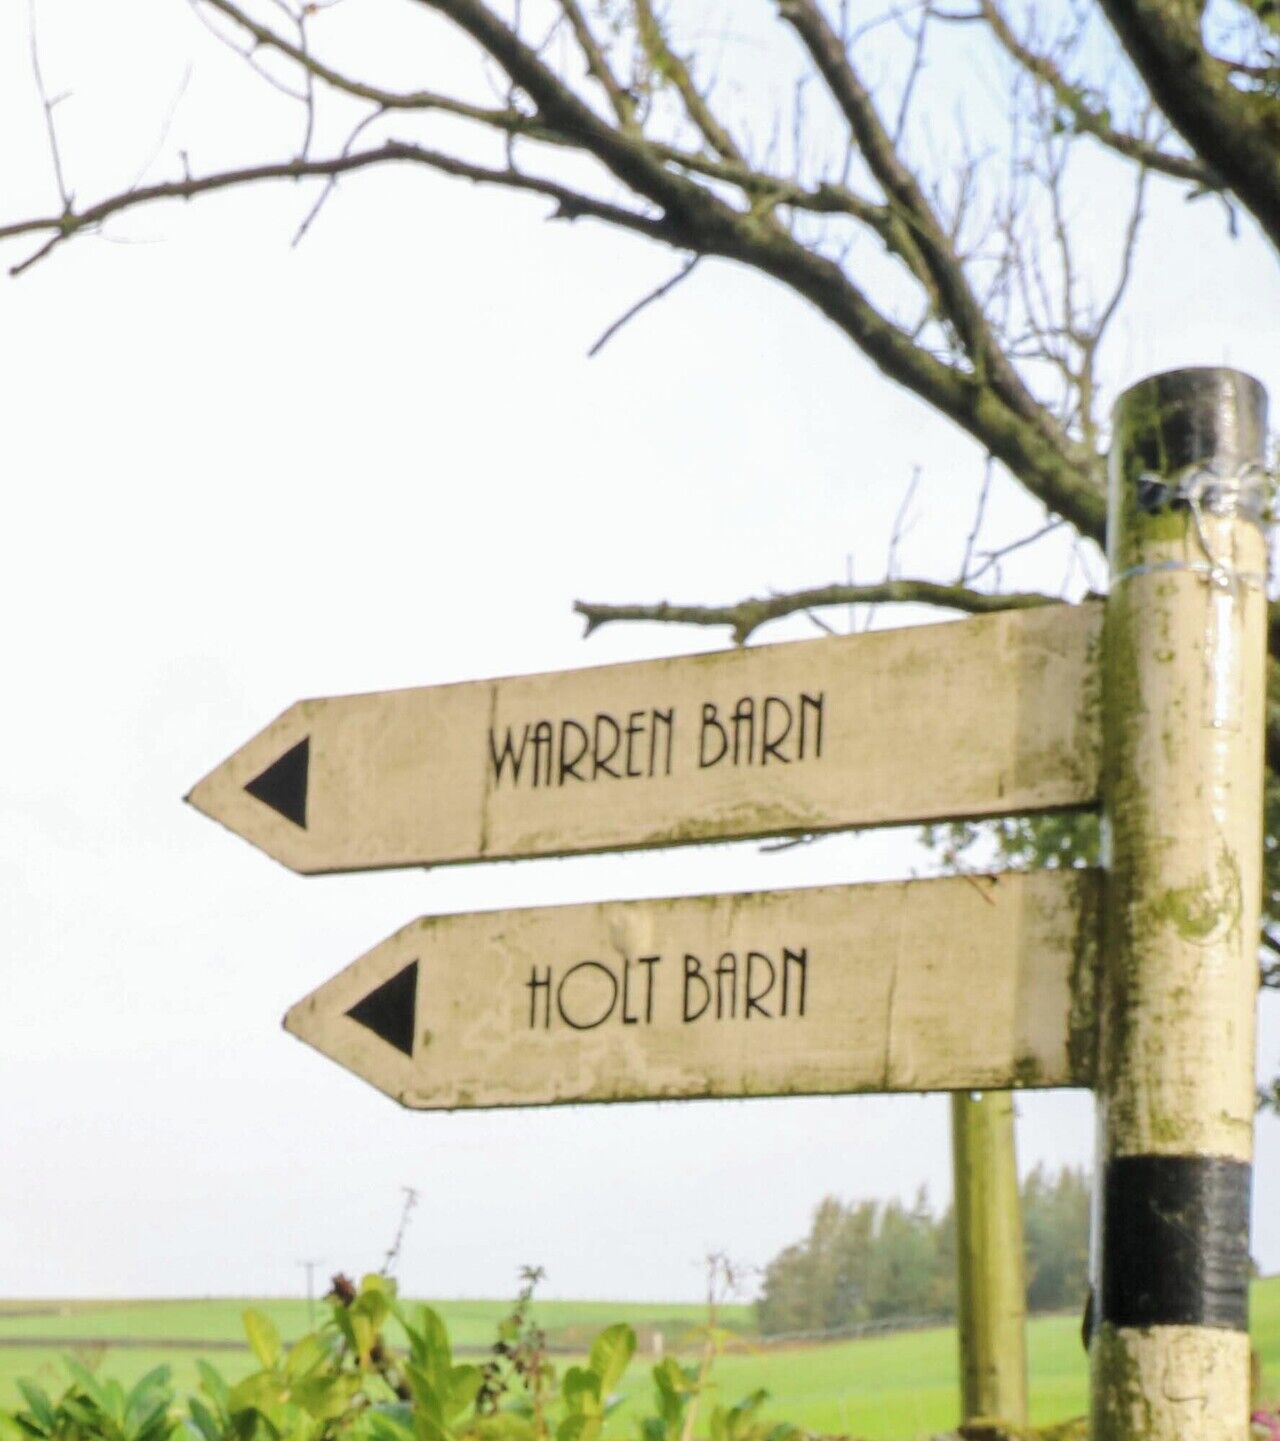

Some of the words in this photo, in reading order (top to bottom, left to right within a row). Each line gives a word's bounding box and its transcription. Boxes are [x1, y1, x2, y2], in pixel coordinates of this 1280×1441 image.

[489, 707, 675, 788] WARREN
[698, 692, 824, 768] BARN
[526, 955, 661, 1030] HOLT
[682, 948, 808, 1024] BARN
